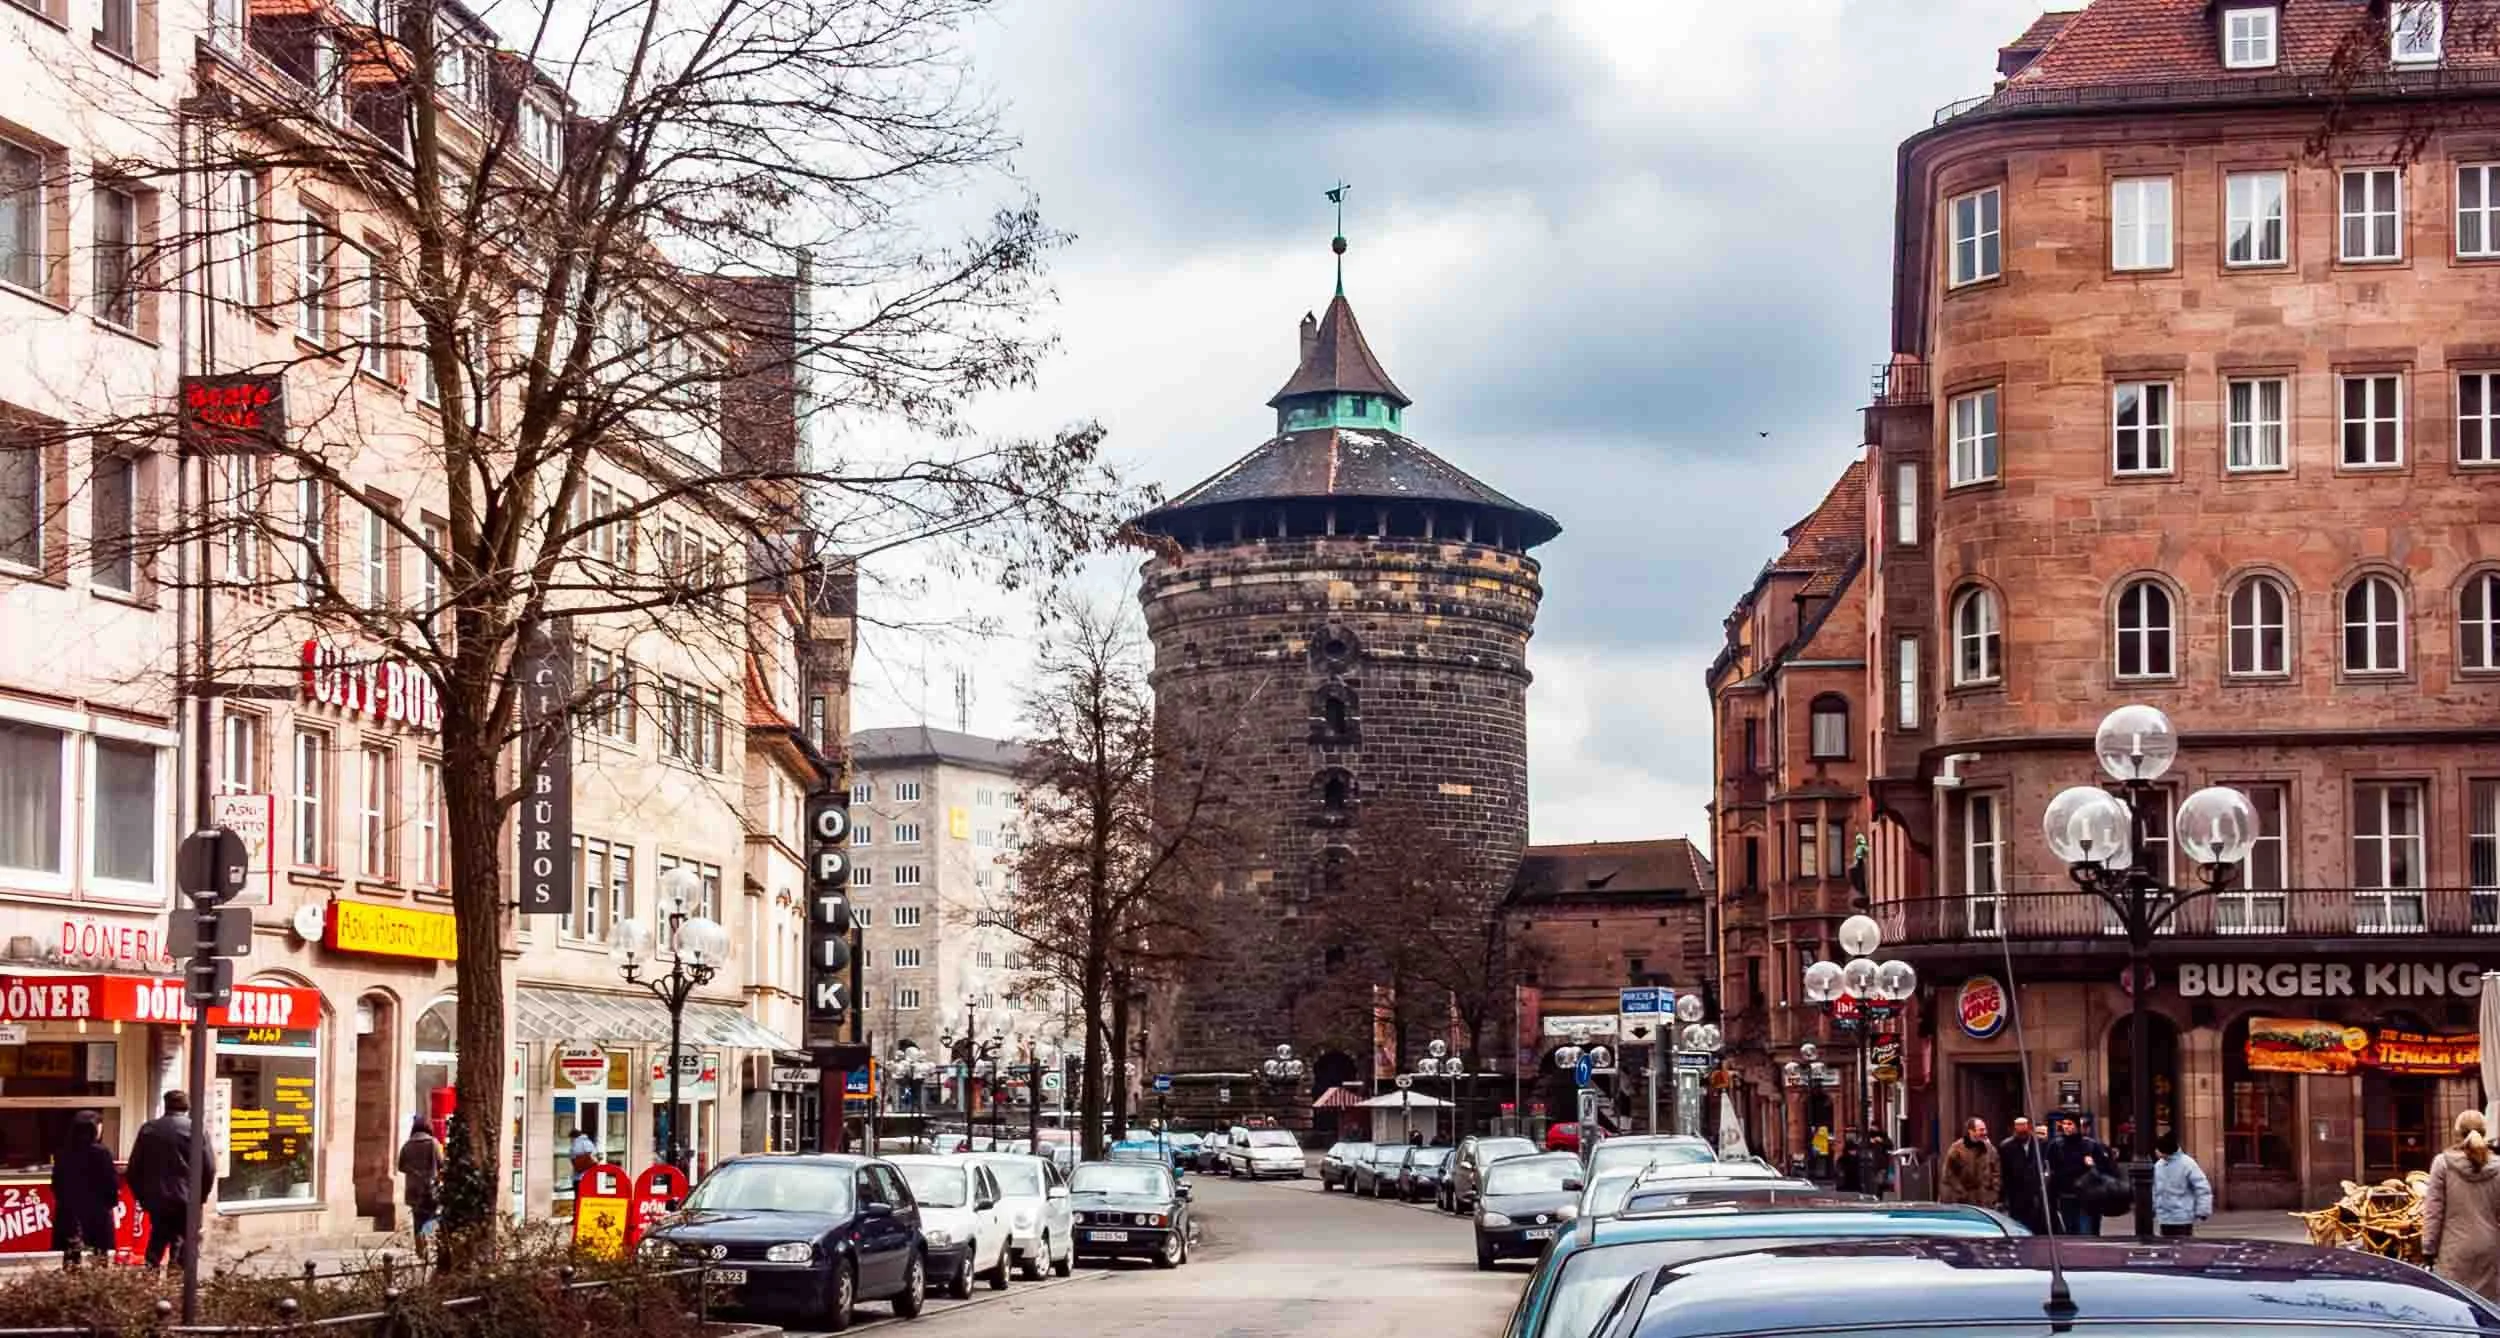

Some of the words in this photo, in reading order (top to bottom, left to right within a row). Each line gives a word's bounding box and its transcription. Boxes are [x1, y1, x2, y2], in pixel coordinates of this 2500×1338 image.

[816, 809, 844, 1009] OPTIK
[136, 976, 198, 1022] DÖNE
[228, 990, 292, 1025] KEBAP
[2178, 963, 2353, 997] BURGER
[2365, 963, 2482, 996] KING
